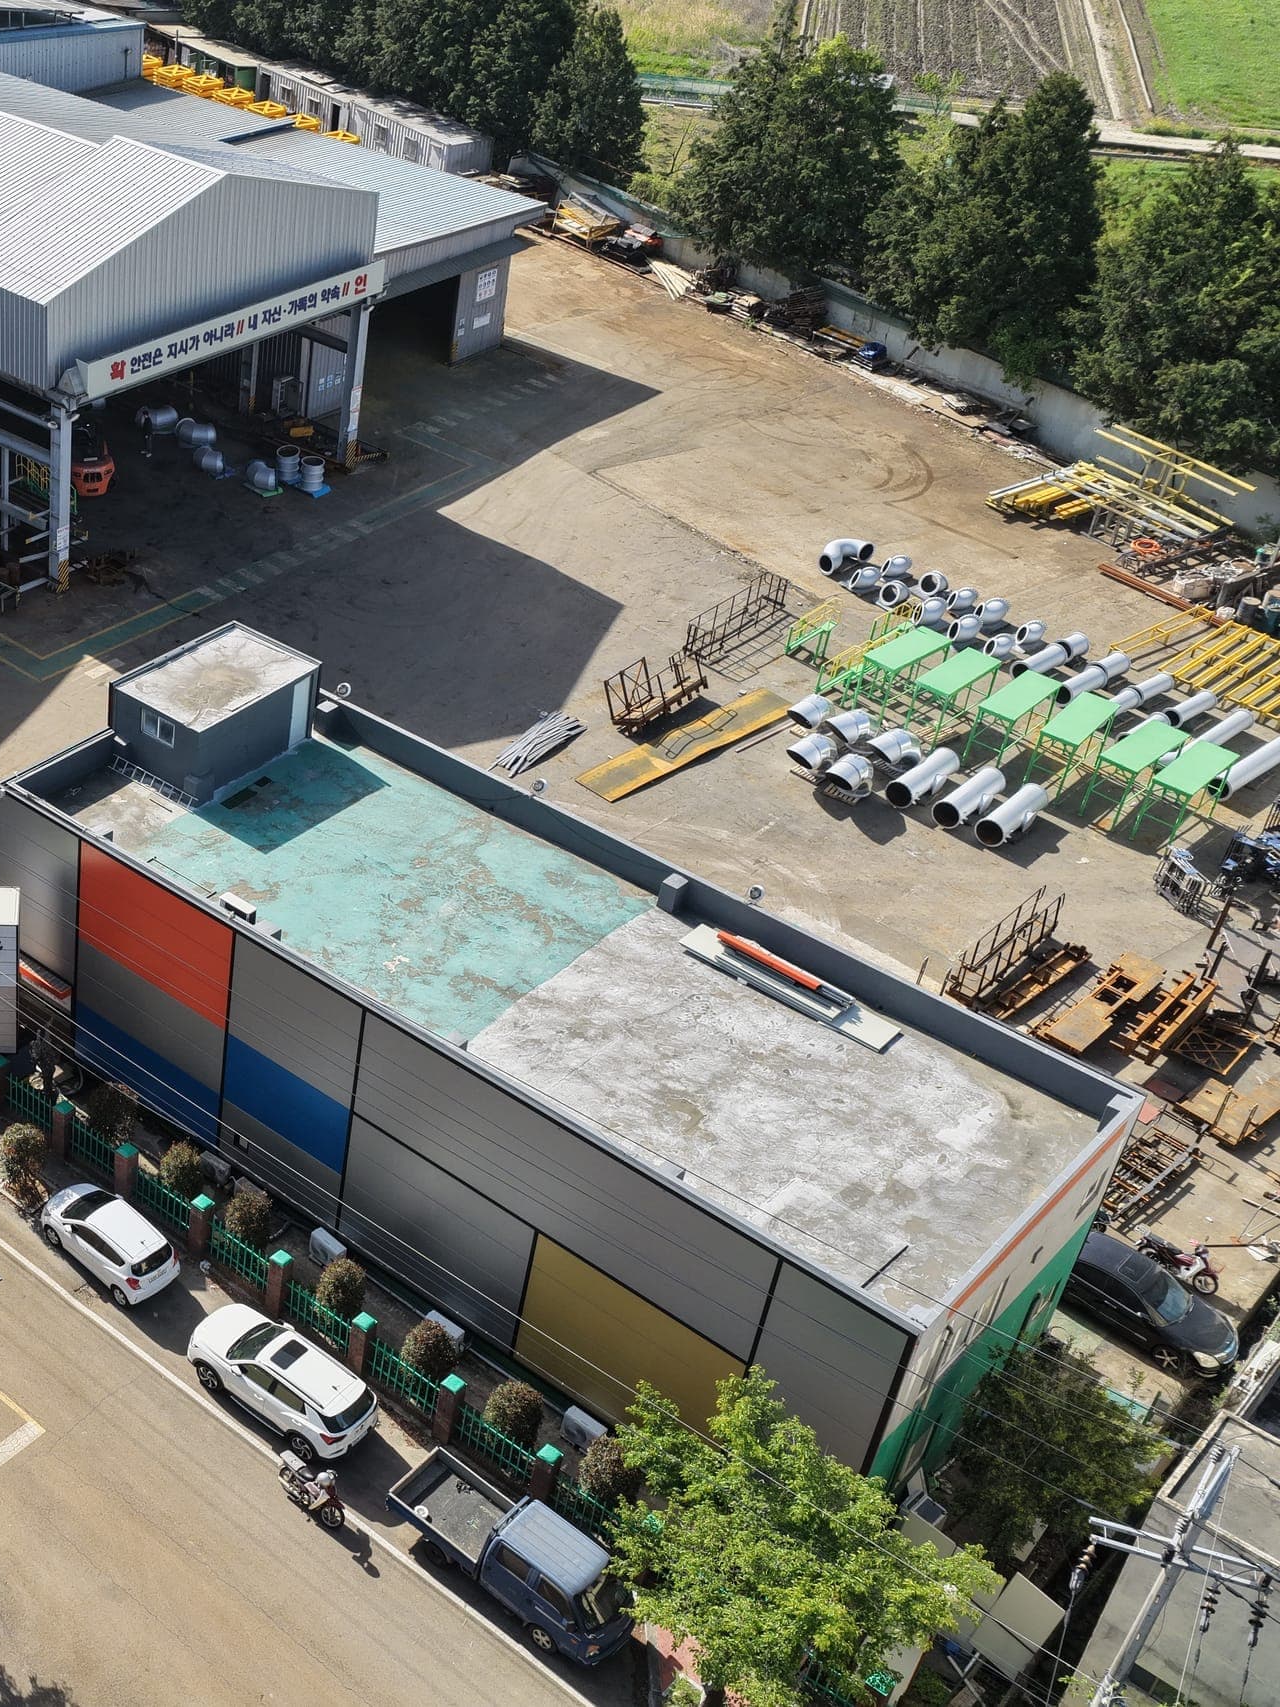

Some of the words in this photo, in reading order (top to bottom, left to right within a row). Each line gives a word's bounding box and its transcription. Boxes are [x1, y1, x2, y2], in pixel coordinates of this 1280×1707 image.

[130, 347, 163, 374] 안전은
[167, 335, 200, 359] 지시가
[248, 313, 258, 331] 내
[354, 273, 368, 295] 인
